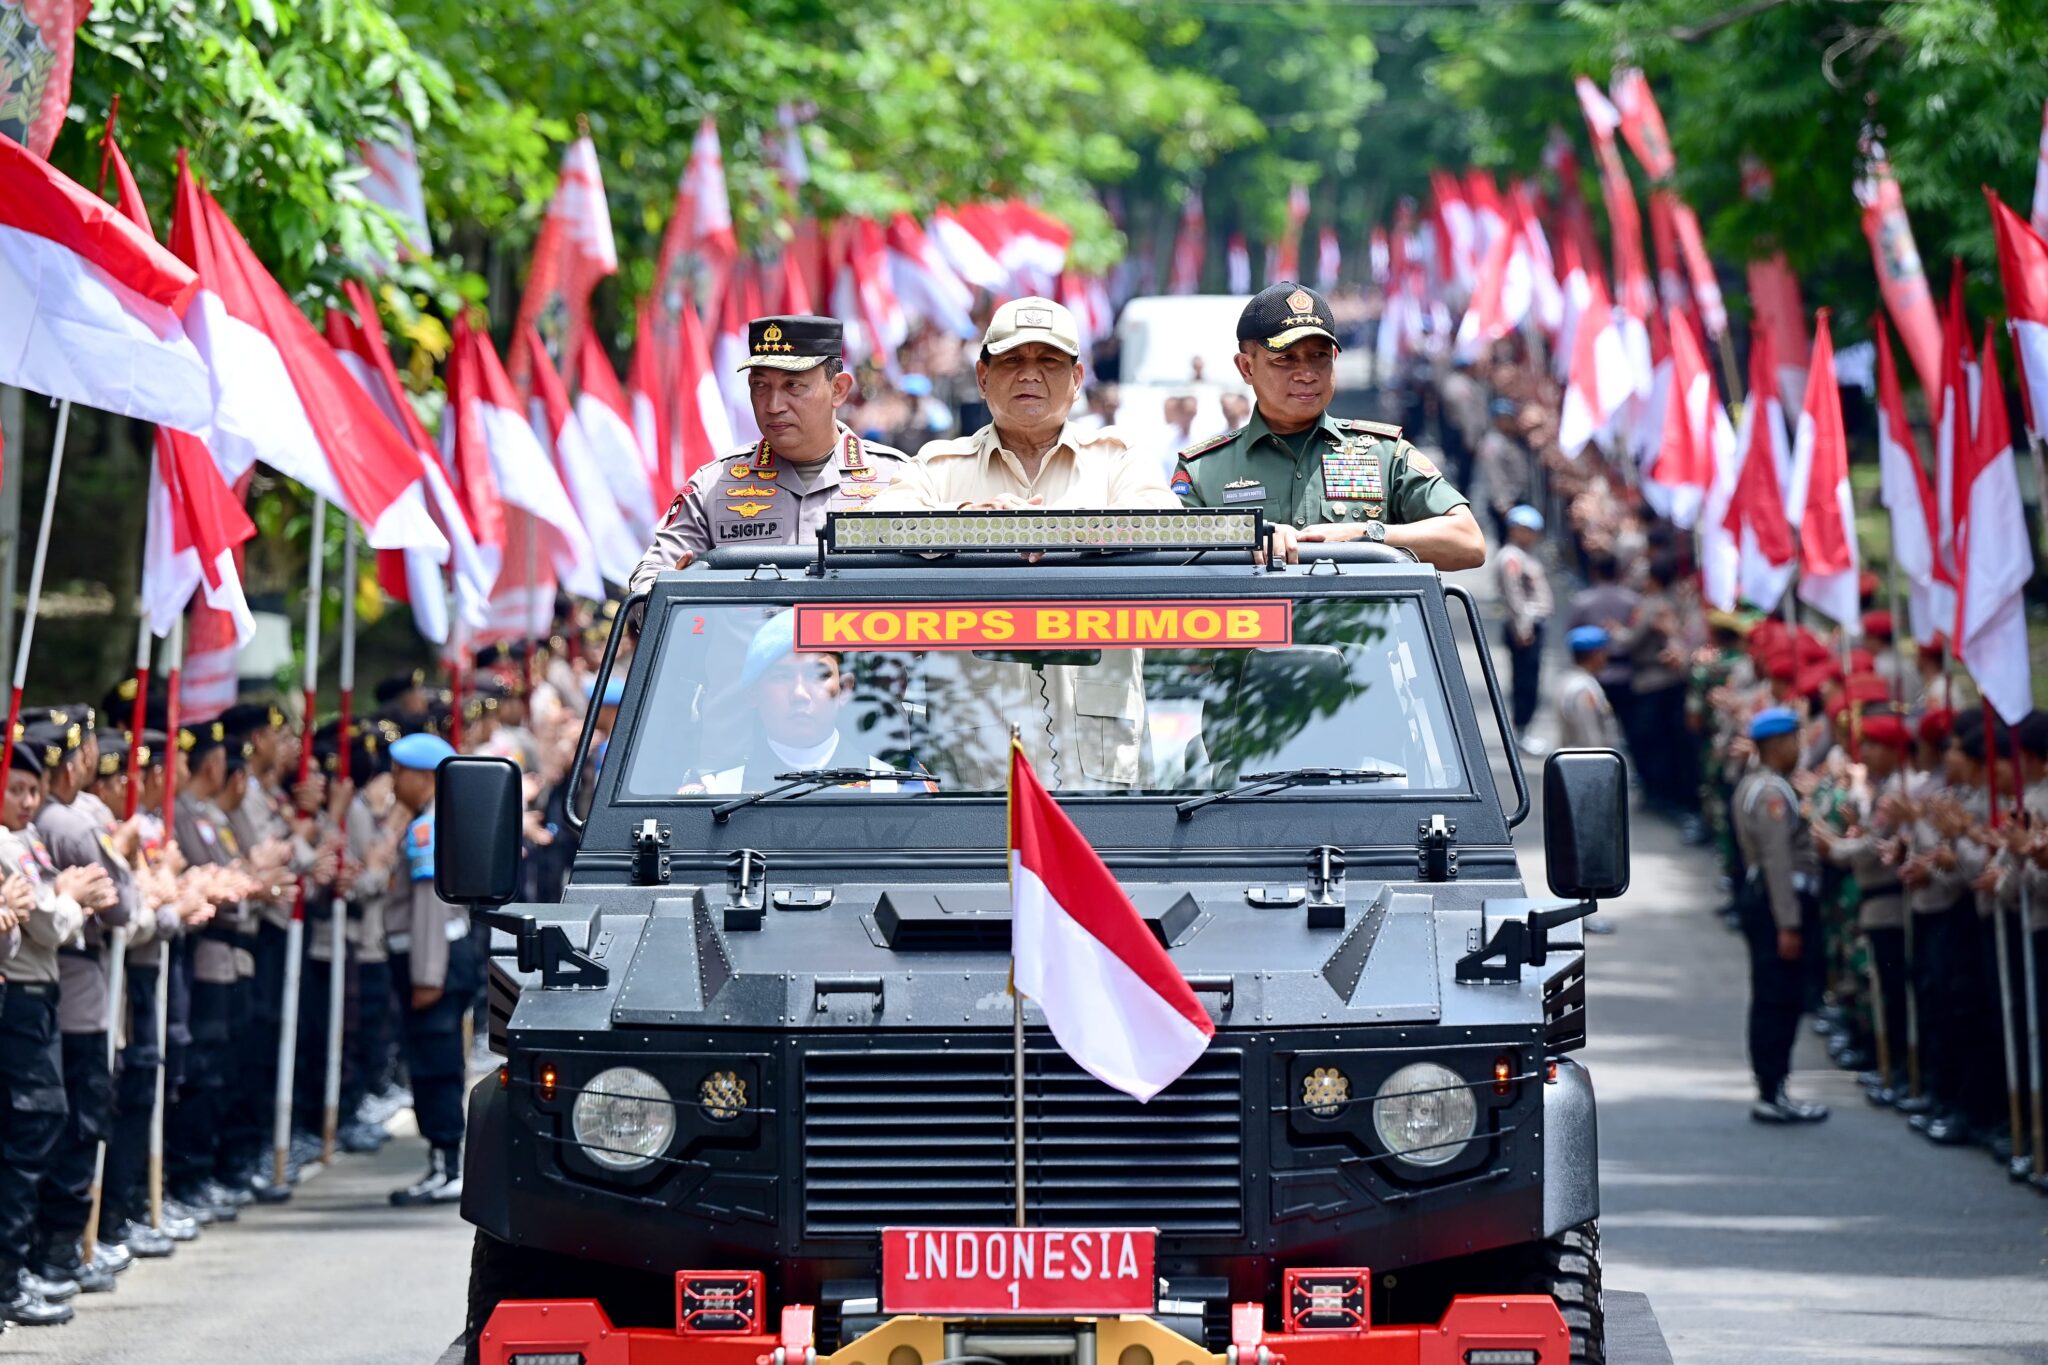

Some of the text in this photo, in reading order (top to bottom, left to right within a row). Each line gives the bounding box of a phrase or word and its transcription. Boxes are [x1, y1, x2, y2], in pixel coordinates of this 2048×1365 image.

[720, 522, 778, 540] L.SIGIT.P
[691, 615, 705, 635] 2
[822, 608, 1263, 642] KORPS BRIMOB
[904, 1231, 1139, 1280] INDONESIA
[1007, 1280, 1021, 1310] 1
